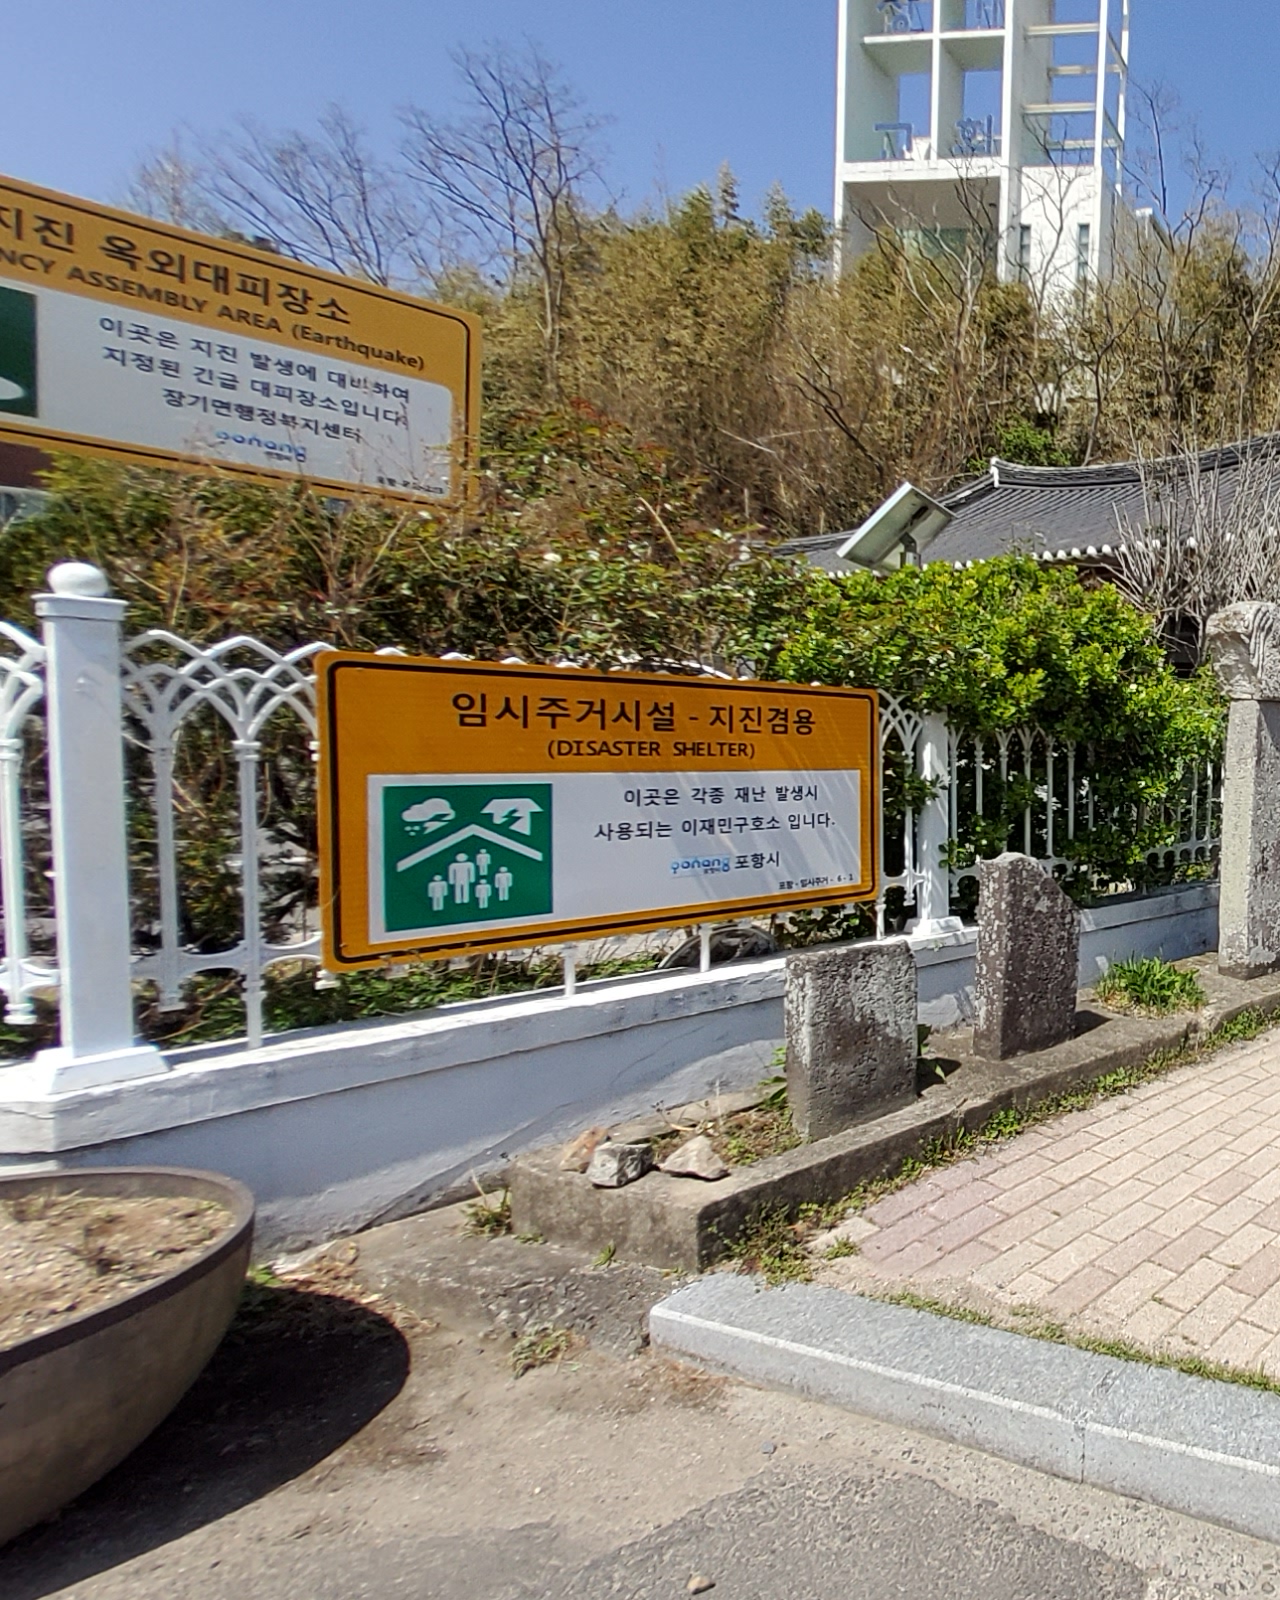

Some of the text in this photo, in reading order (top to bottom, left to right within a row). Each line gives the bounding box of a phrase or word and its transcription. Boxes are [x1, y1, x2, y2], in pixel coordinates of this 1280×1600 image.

[0, 204, 350, 325] 지진 옥외대피장소
[67, 265, 208, 314] ASSEMBLY
[217, 304, 283, 334] AREA
[292, 323, 425, 371] (Earthquake)
[99, 317, 410, 404] 이곳은 지진 발생에 대비하여
[102, 346, 182, 379] 지정된
[193, 366, 240, 391] 긴급
[162, 387, 362, 444] 장기면행정복지센터
[451, 692, 676, 732] 임시주거시설
[708, 704, 817, 736] 지진겸용
[547, 739, 756, 761] (DISASTER SHELTER)
[623, 785, 819, 807] 이곳은 각종 재난 발생시
[593, 812, 836, 842] 사용되는 이재민구호소 입니다.
[734, 850, 780, 870] 포항시
